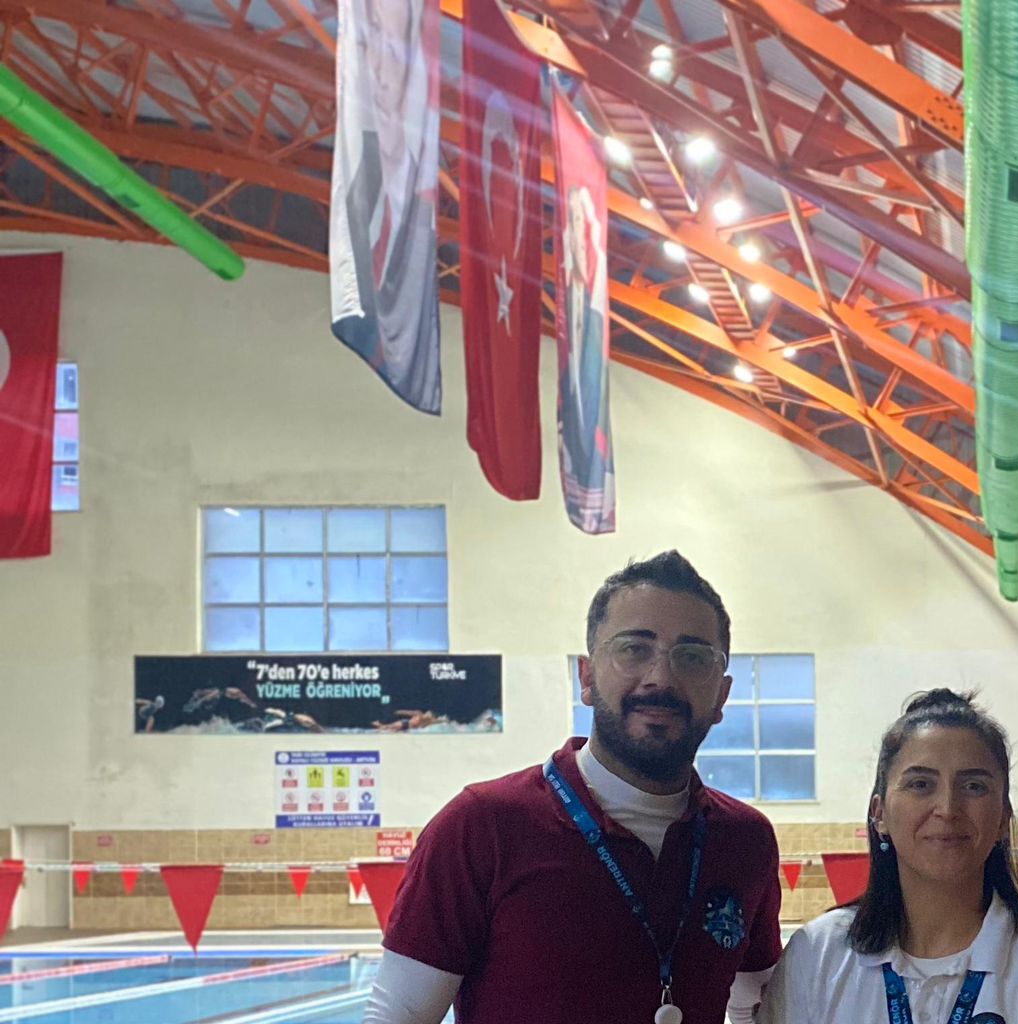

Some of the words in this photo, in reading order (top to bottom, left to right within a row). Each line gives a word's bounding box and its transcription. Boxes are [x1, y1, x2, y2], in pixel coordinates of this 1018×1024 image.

[332, 663, 380, 680] herkes
[256, 682, 301, 699] YÜZME
[393, 846, 411, 857] CM
